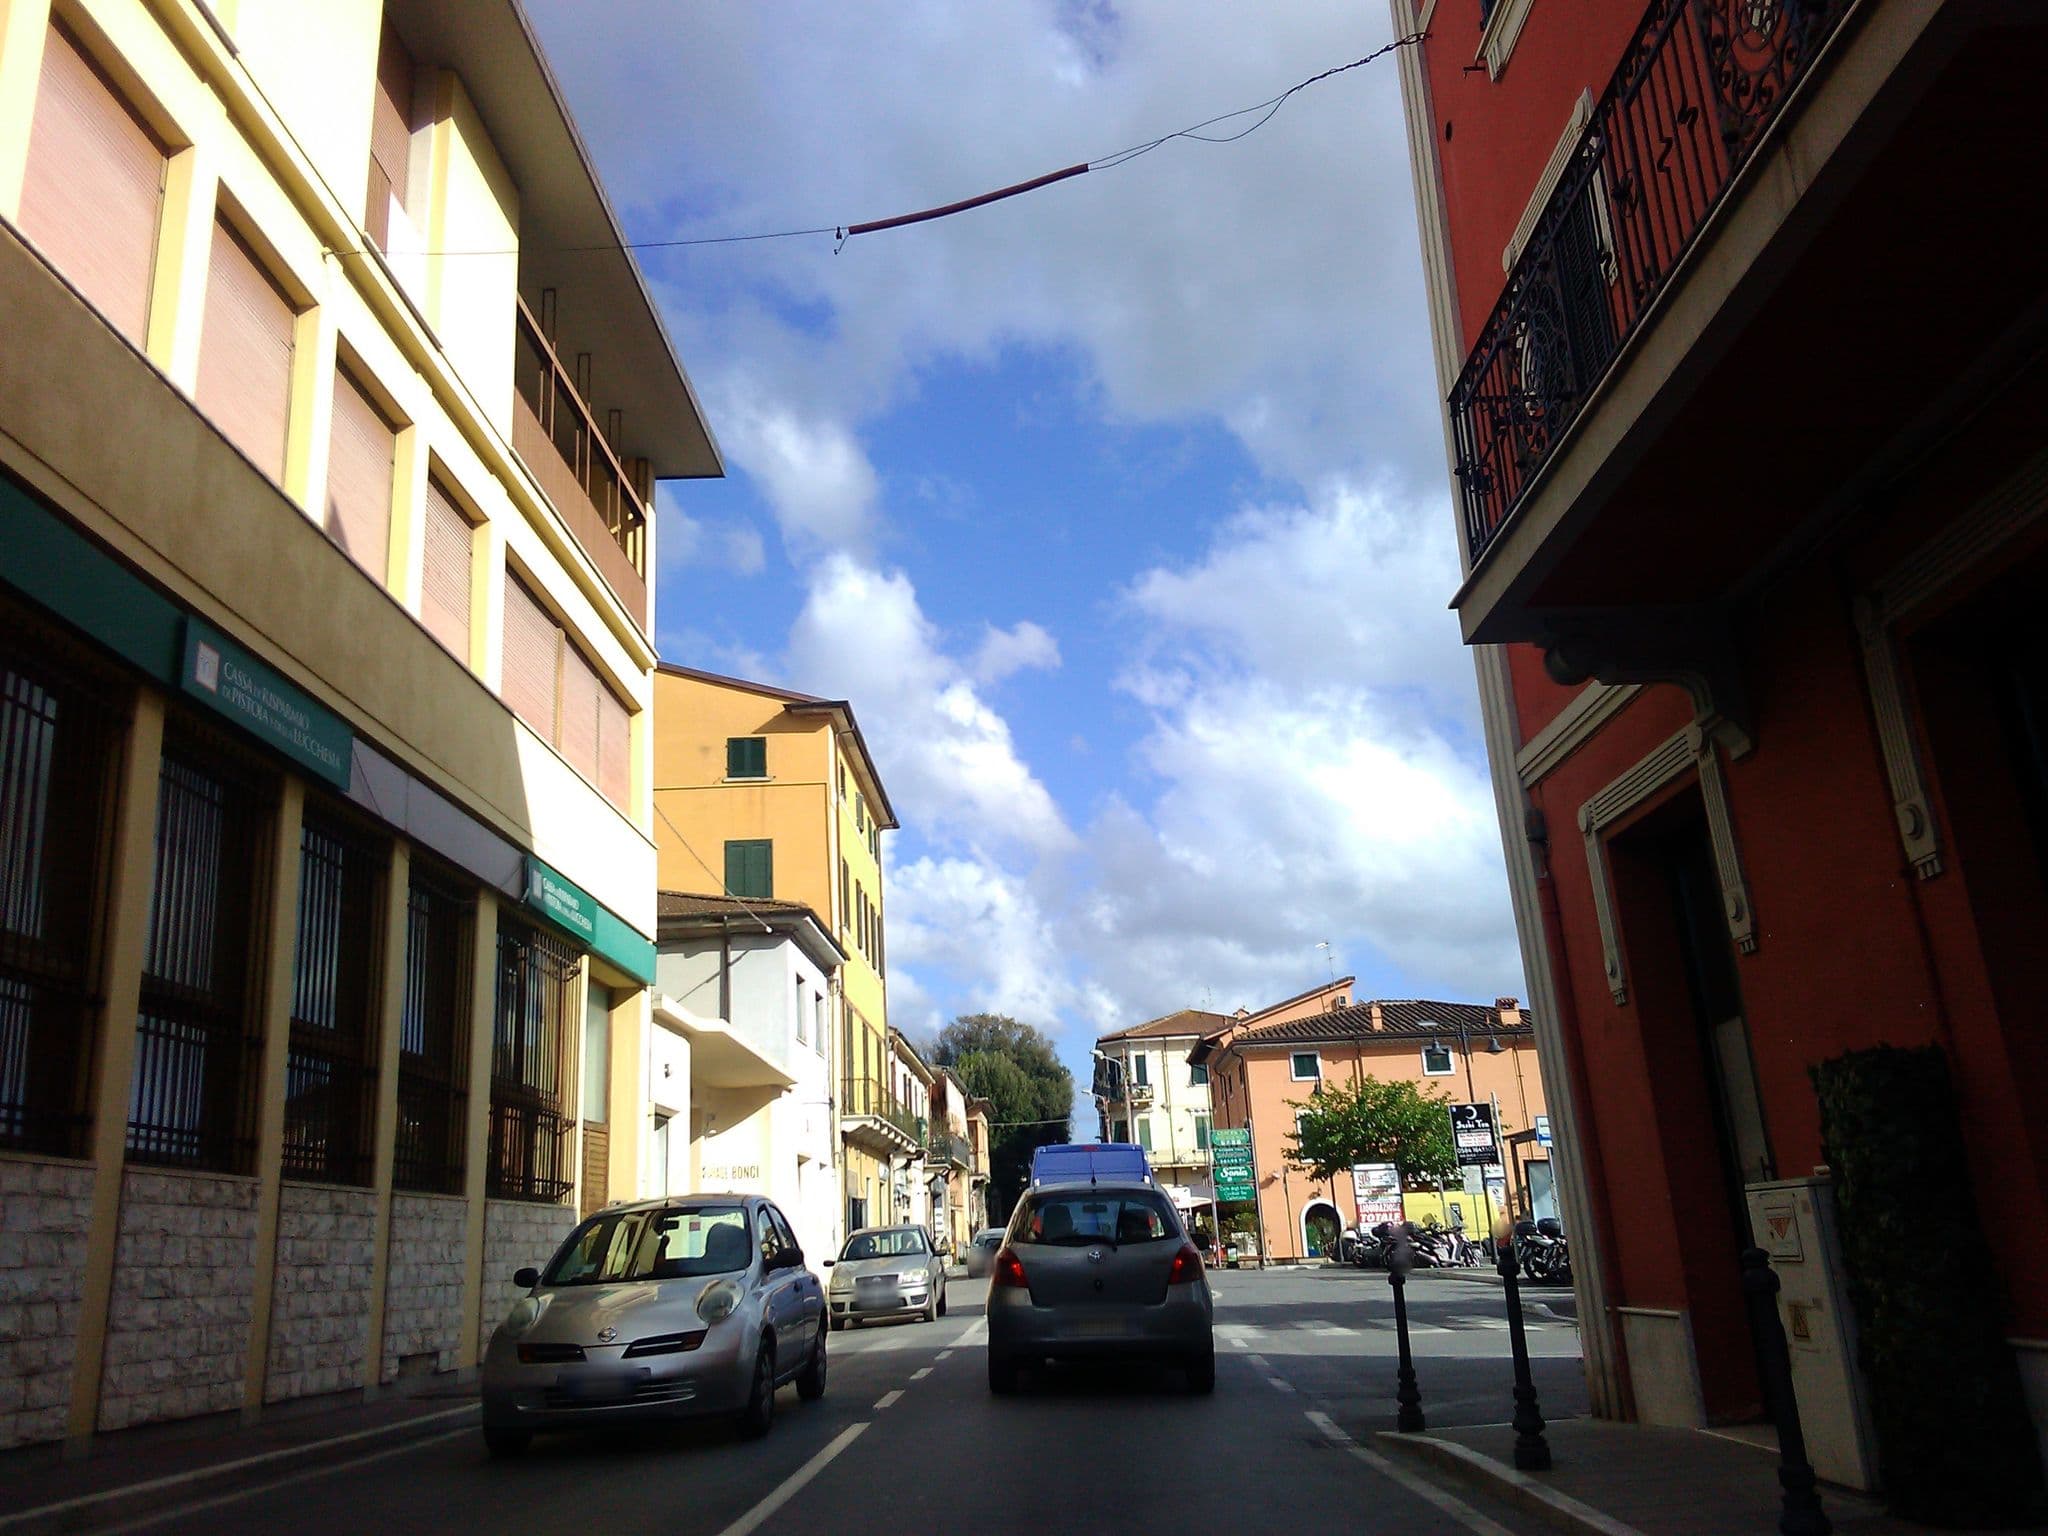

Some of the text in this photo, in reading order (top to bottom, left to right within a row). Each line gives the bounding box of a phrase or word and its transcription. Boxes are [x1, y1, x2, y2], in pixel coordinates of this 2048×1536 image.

[224, 662, 254, 694] CASSA
[232, 687, 268, 722] PISTOIA
[732, 1165, 759, 1180] BONCI
[1360, 1212, 1401, 1223] TOTALE
